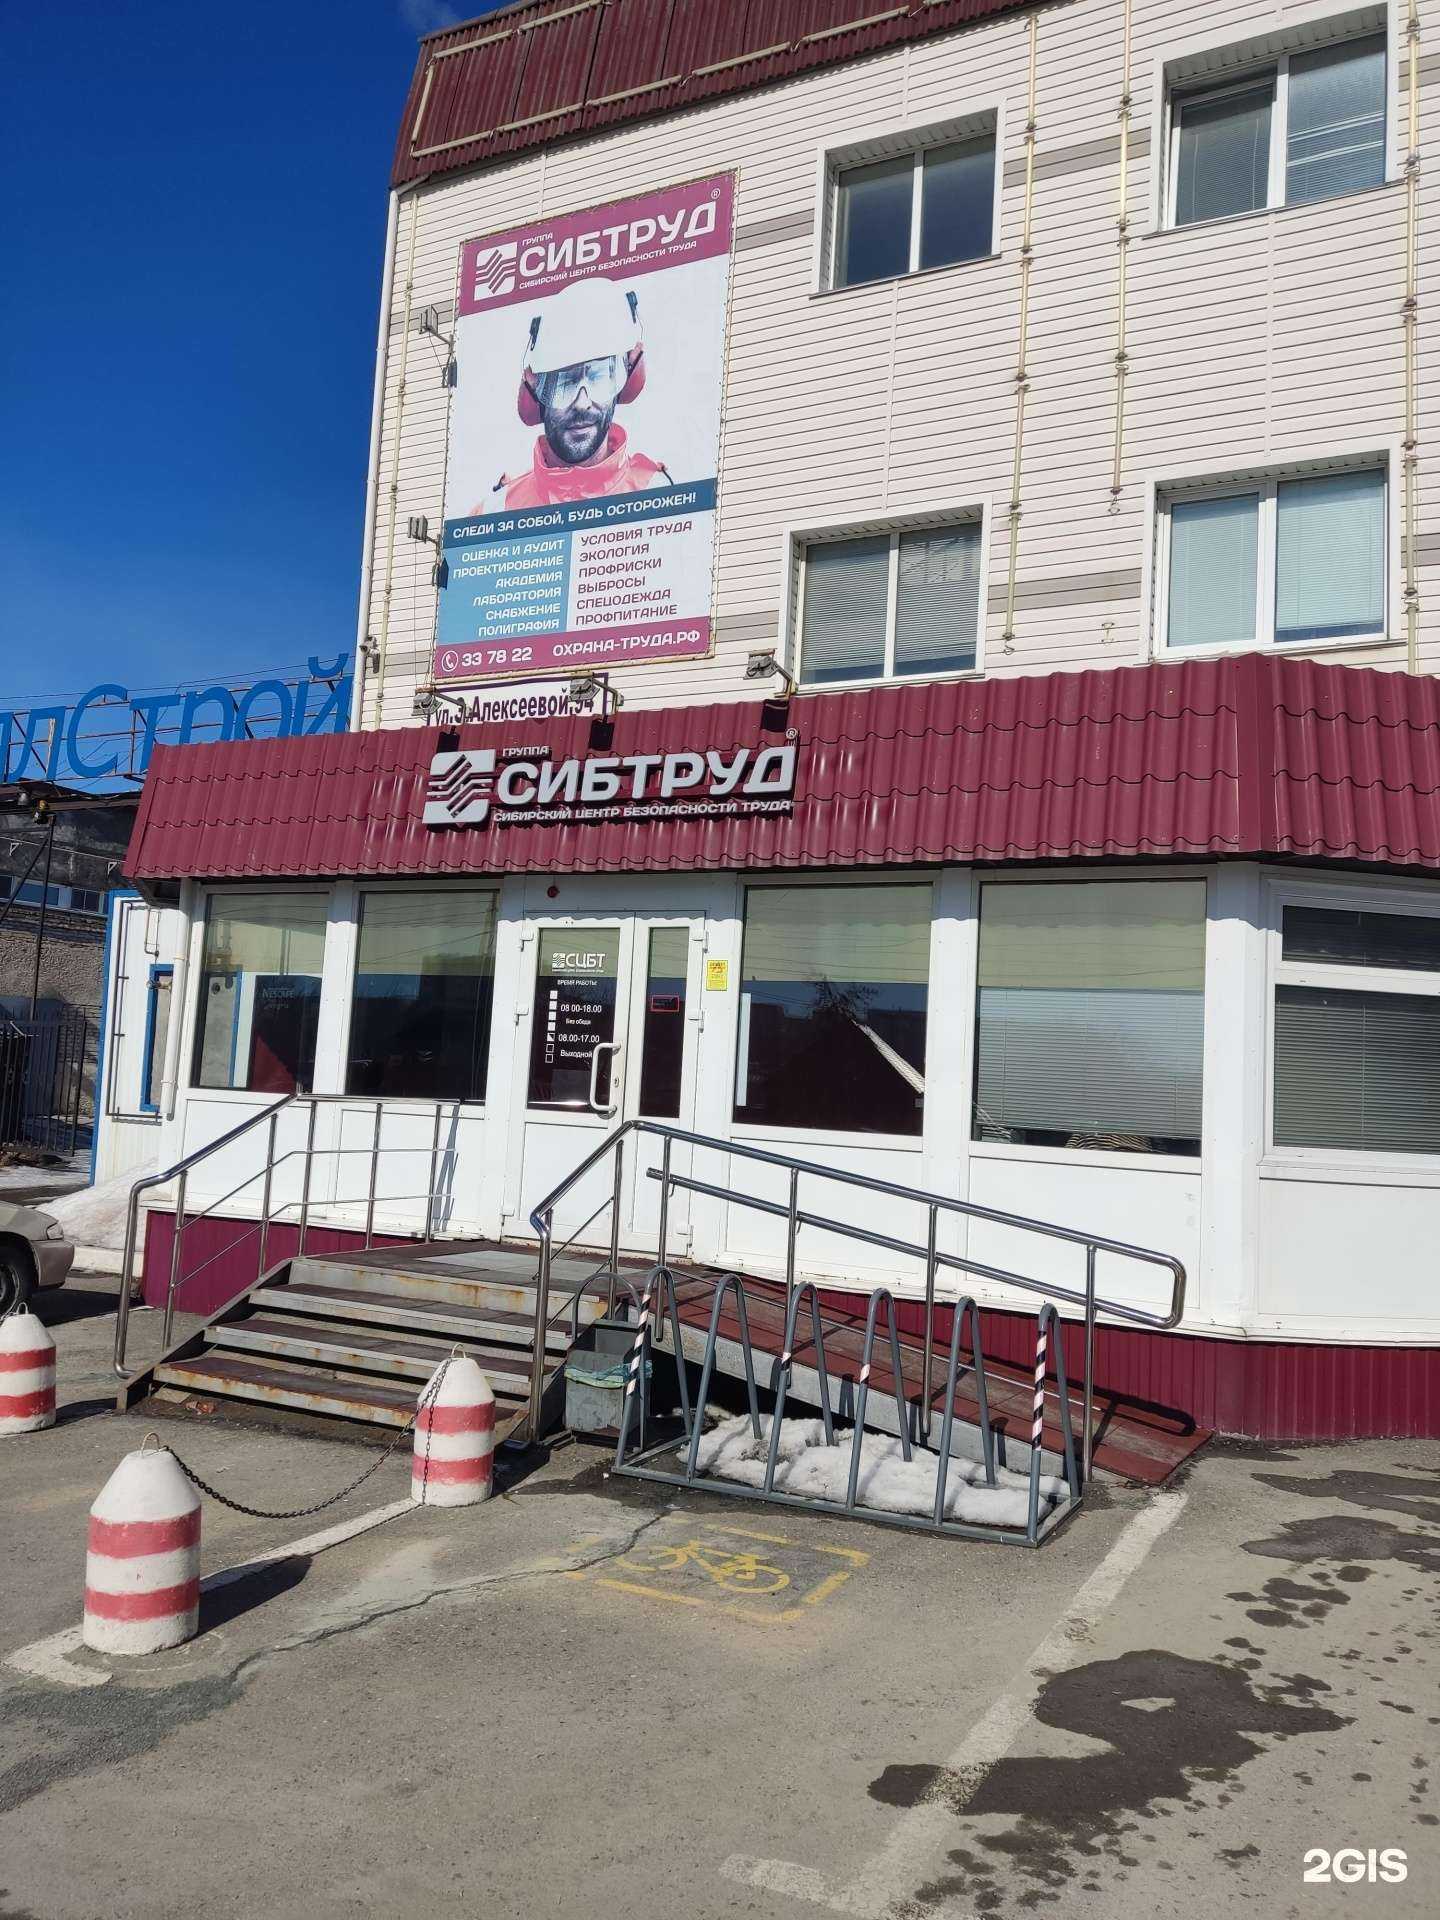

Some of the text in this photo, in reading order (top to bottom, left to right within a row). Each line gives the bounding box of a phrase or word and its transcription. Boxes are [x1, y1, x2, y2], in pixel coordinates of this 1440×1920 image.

[519, 201, 717, 277] СИБТРУД
[522, 232, 553, 246] ГРУППА
[519, 240, 697, 290] СИБИРСКИЙ ЦЕНТР БЕЗОПАСНОСТИ ТРУДА
[453, 492, 697, 539] СЛЕДИ ЗА СОБОЙ, БУДЬ ОСТОРОЖЕН!
[581, 520, 692, 547] УСЛОВИЯ ТРУДА
[461, 539, 565, 562] ОЦЕНКА И АУДИТ
[579, 543, 650, 562] ЭКОЛОГИЯ
[453, 555, 564, 579] ПРОЕКТИРОВАНИЕ
[578, 557, 662, 578] ПРОФРИСКИ
[495, 571, 563, 588] АКАДЕМИЯ
[577, 576, 646, 594] ВЫБРОСЫ
[473, 587, 562, 607] ЛАБОРАТОРИЯ
[576, 588, 671, 609] СПЕЦОДЕЖДА
[485, 603, 561, 621] СНАБЖЕНИЕ
[575, 604, 678, 626] ПРОФПИТАНИЕ
[478, 618, 560, 638] ПОЛИГРАФИЯ
[552, 629, 701, 657] ОХРАНА-ТРУДА.РФ
[461, 646, 533, 667] 33 78 22
[502, 745, 550, 757] ГРУППА
[497, 745, 796, 805] СИБТРУД
[493, 800, 793, 822] СИБИРСКИЙ ЦЕНТР БЕЗОПАСНОСТИ ТРУДА
[565, 953, 606, 968] СЦБТ
